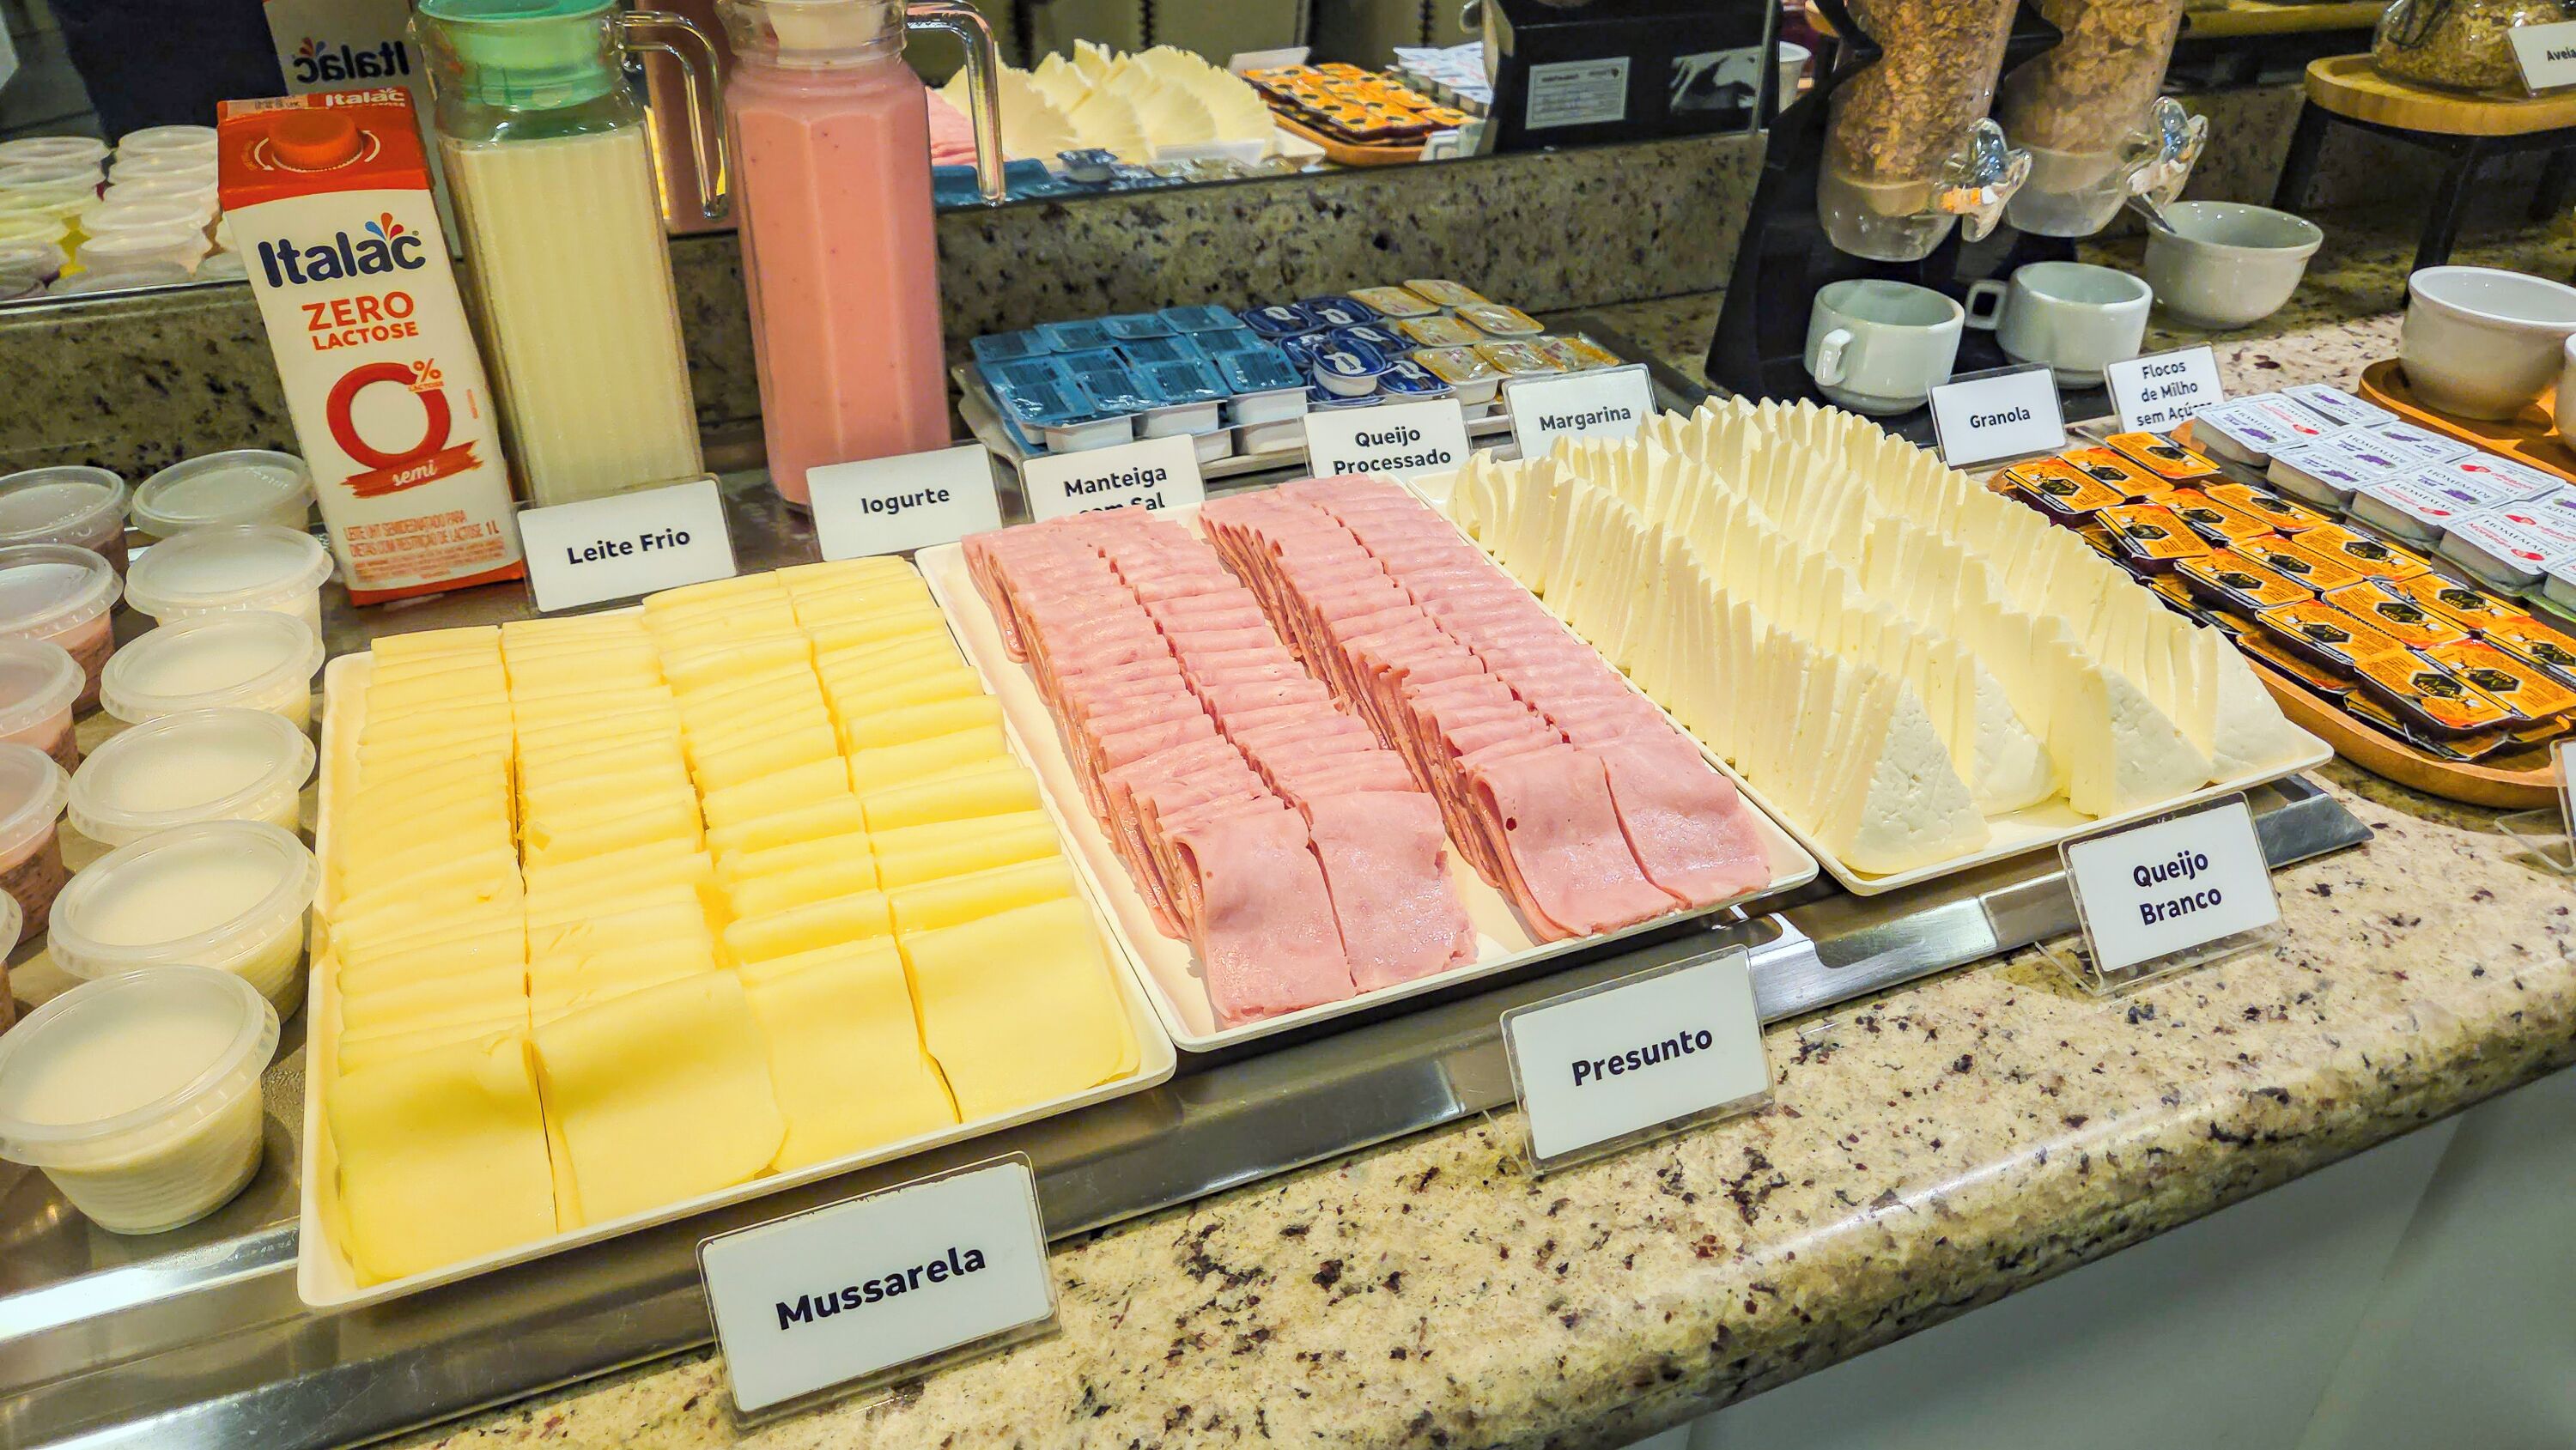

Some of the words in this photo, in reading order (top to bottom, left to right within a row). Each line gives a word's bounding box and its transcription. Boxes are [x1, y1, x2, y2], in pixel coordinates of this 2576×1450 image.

[325, 88, 405, 107] Italac
[258, 231, 427, 288] Italac
[301, 291, 414, 331] ZERO
[312, 321, 419, 350] LACTOSE
[2141, 361, 2186, 379] Flocos
[2141, 387, 2157, 403] de
[2160, 380, 2198, 398] Milho
[1539, 406, 1631, 431] Margarina
[1969, 406, 2031, 428] Granola
[2136, 411, 2165, 427] sem
[2168, 402, 2213, 422] Açú
[1354, 426, 1421, 448] Queijo
[392, 459, 439, 486] semi
[1333, 448, 1452, 476] Processado
[1063, 466, 1168, 497] Manteiga
[860, 488, 951, 515] Iogurte
[567, 539, 635, 566] Leite
[639, 527, 691, 552] Frio
[2133, 849, 2209, 889] Queijo
[2139, 888, 2222, 926] Branco
[1571, 1029, 1714, 1087] Presunto
[775, 1247, 987, 1332] Mussarela
